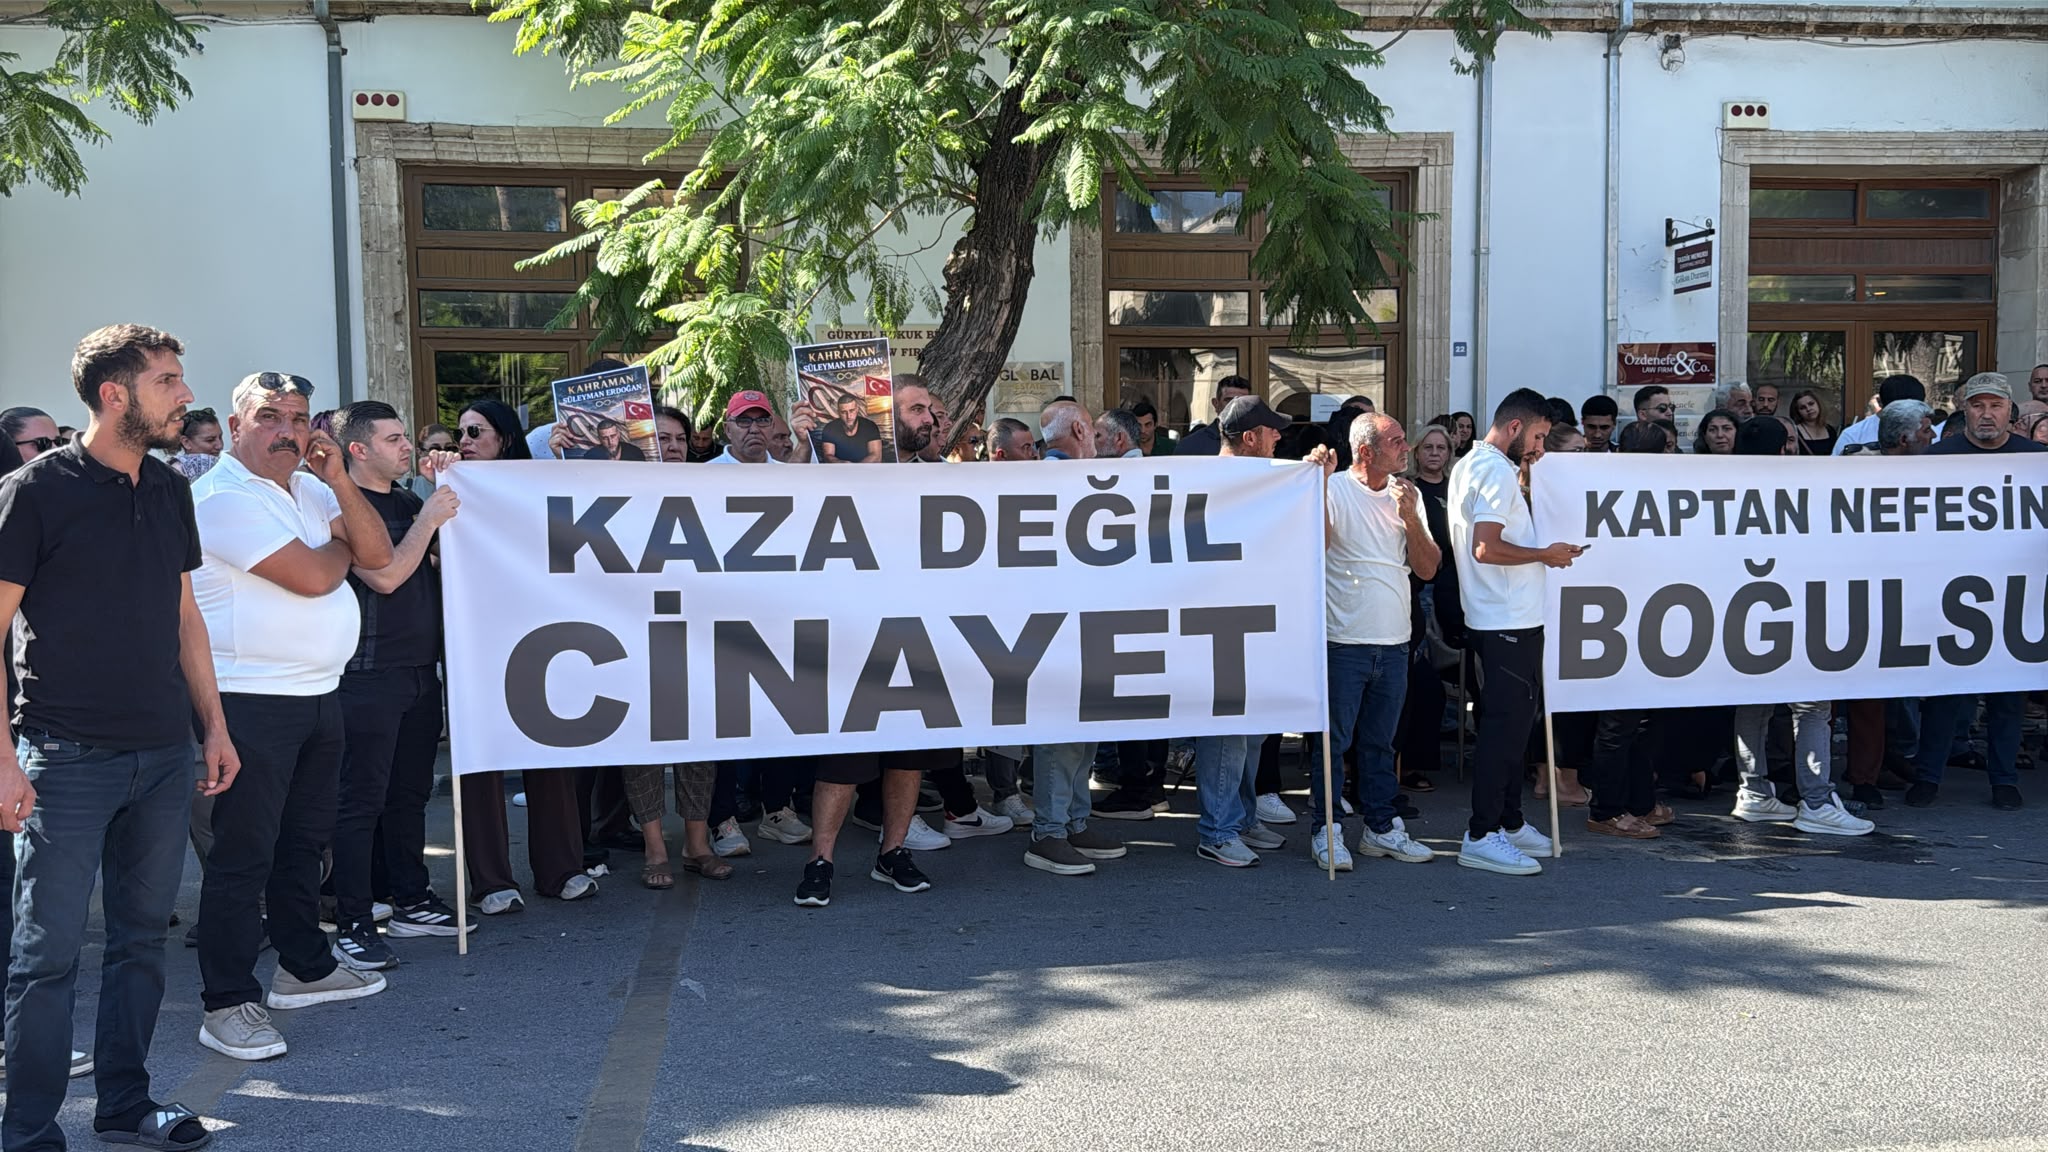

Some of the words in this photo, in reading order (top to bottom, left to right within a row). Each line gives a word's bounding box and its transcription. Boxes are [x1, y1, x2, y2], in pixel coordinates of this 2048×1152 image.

[827, 329, 876, 340] GÜRYEL
[880, 330, 922, 340] HKUK
[808, 346, 876, 362] KAHRAMAN
[901, 348, 922, 357] FIR
[1624, 353, 1676, 365] Özdenefe
[803, 361, 845, 373] SÜLEYMAN
[847, 357, 883, 368] ERDOĞAN
[1000, 369, 1060, 381] GLBAL
[568, 375, 634, 394] KAHRAMAN
[562, 390, 605, 404] SÜLEYMAN
[606, 383, 642, 396] ERDOĞAN
[1586, 489, 1809, 537] KAPTAN
[1831, 475, 2048, 533] NEFESİN
[547, 496, 880, 573] KAZA
[920, 475, 1242, 569] DEĞİL
[1559, 558, 2048, 680] BOĞULSU
[505, 591, 1276, 747] CİNAYET
